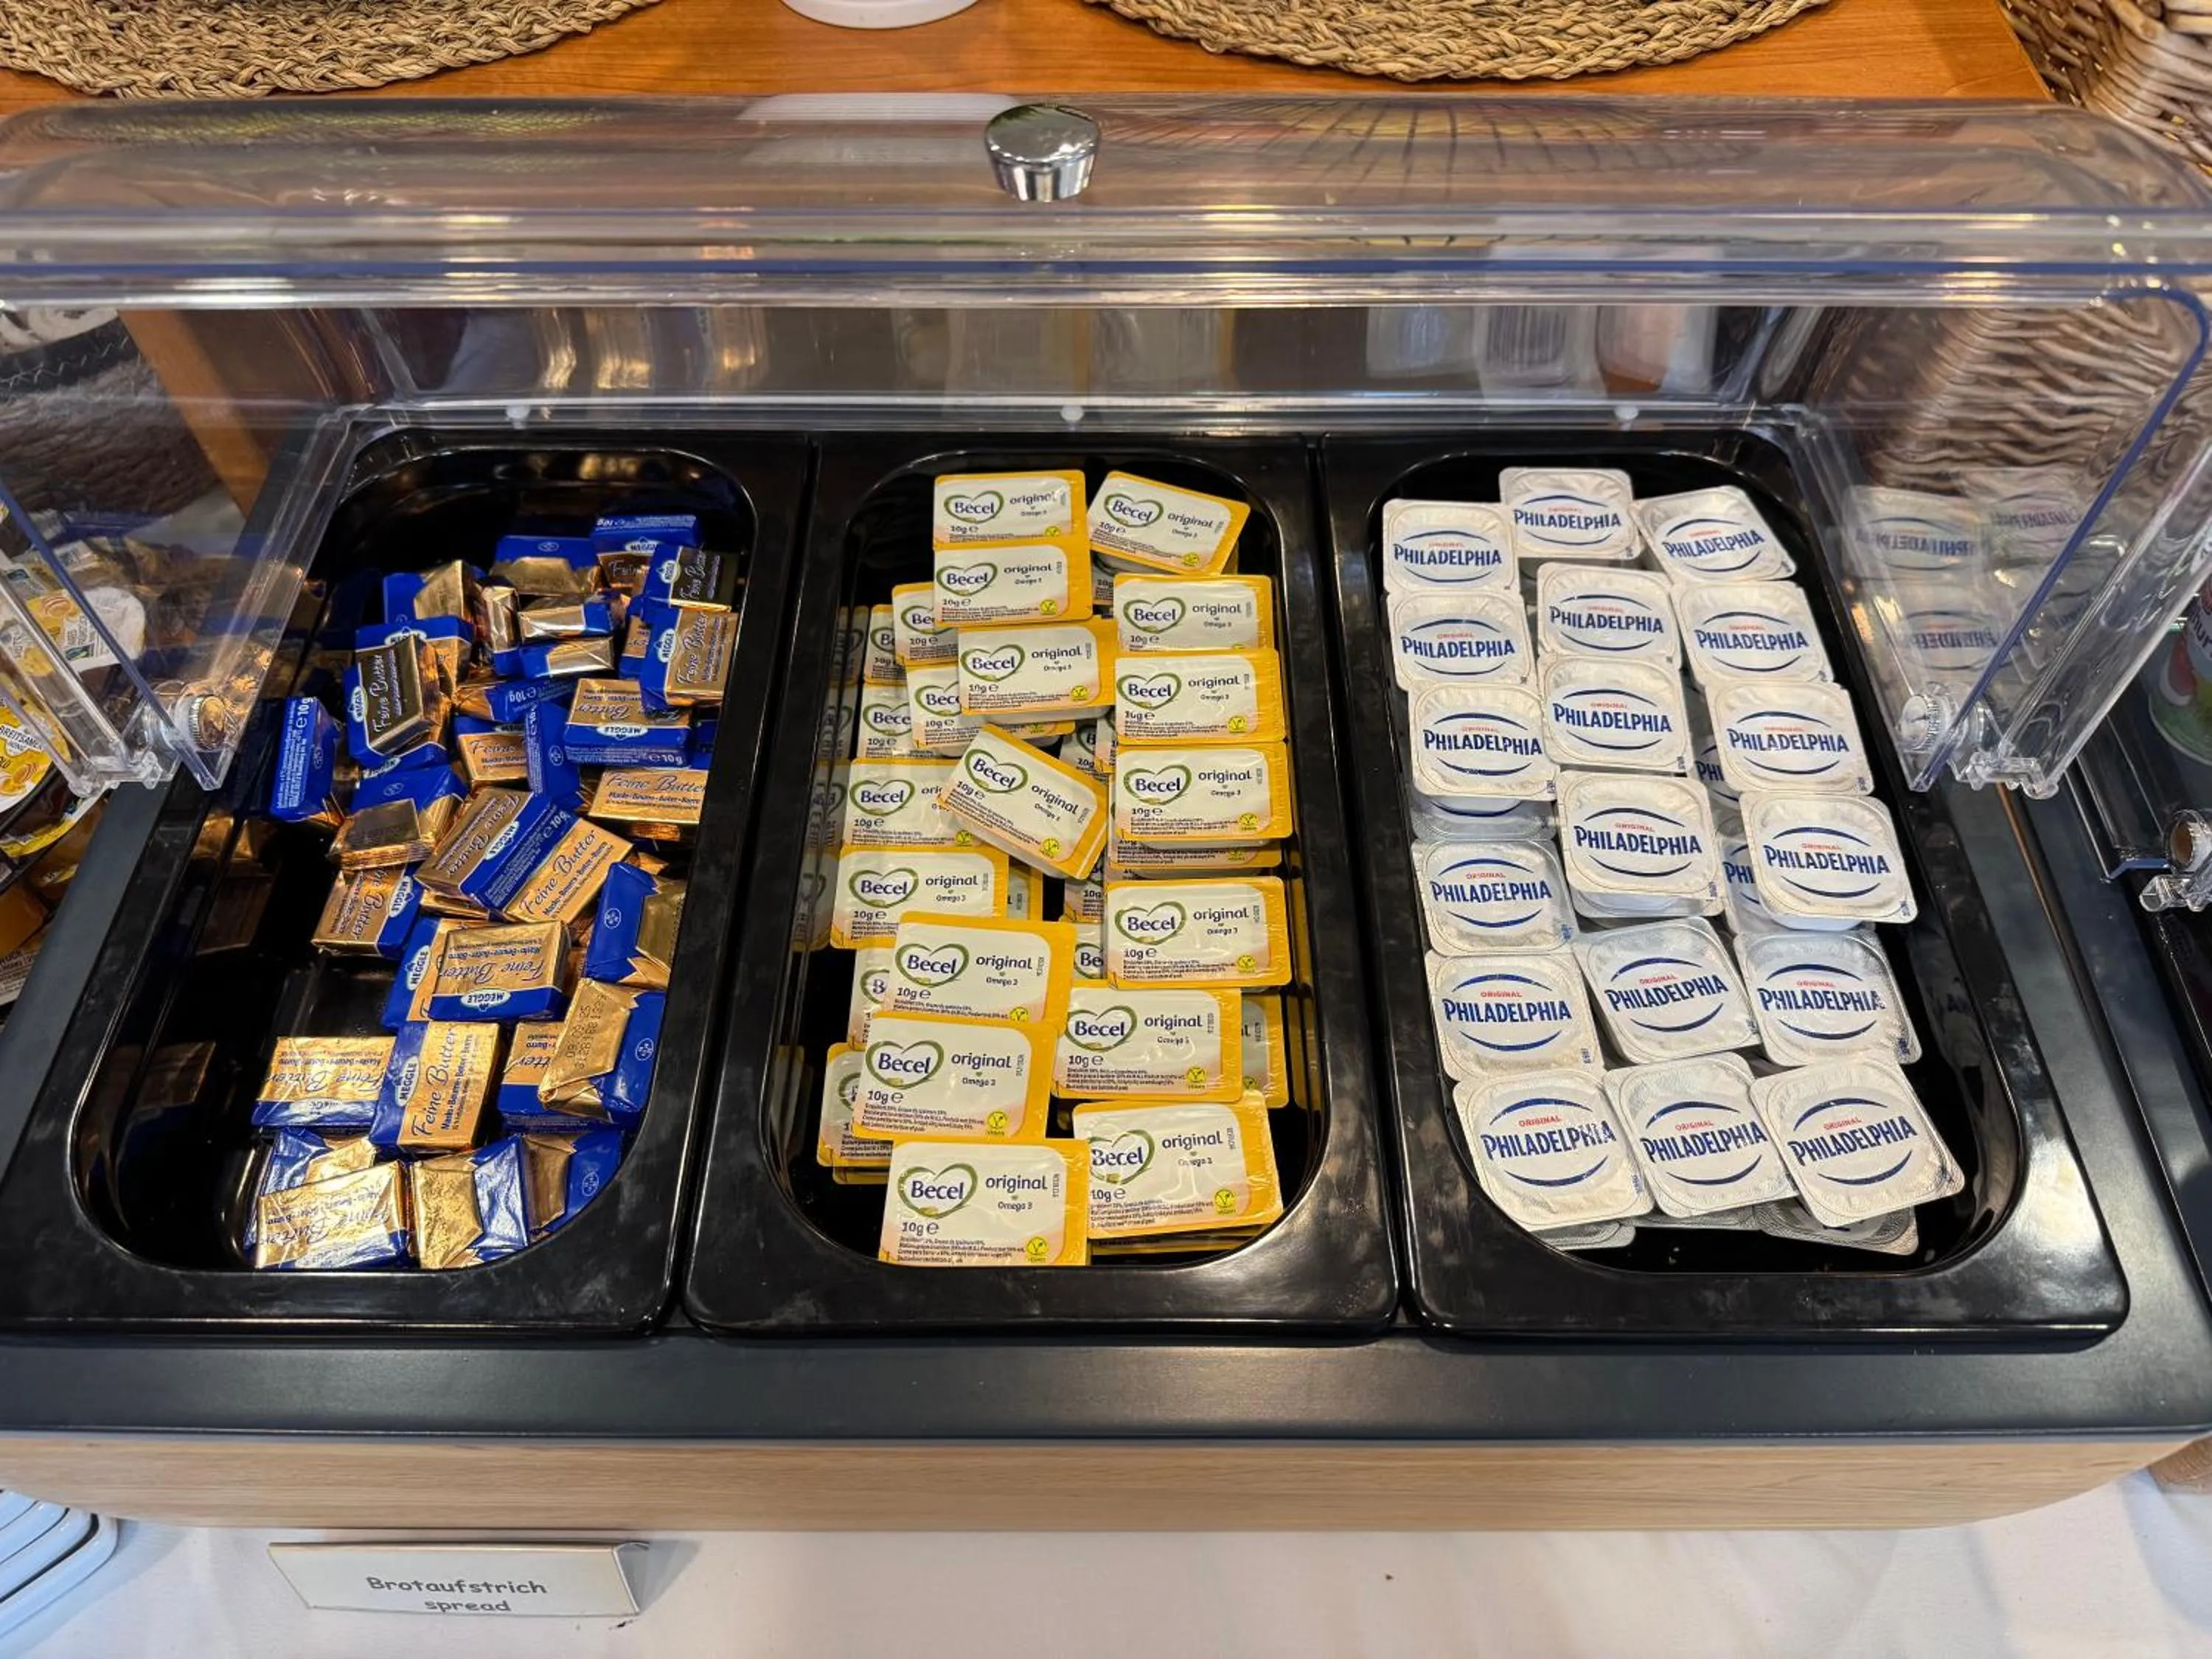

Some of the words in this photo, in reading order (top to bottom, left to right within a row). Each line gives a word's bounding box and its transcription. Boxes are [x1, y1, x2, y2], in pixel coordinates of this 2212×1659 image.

[955, 501, 995, 514] Becel
[1113, 501, 1155, 522] Becel
[1099, 521, 1116, 532] 10g
[1167, 512, 1214, 529] original
[1514, 509, 1621, 530] PHILADELPHIA
[950, 525, 967, 534] 10g
[1663, 529, 1765, 557] PHILADELPHIA
[1394, 543, 1502, 566] PHILADELPHIA
[1004, 563, 1053, 575] original
[947, 571, 989, 585] Becel
[942, 598, 959, 608] 10g
[1192, 602, 1242, 615] original
[1134, 608, 1176, 622] Becel
[1549, 605, 1663, 633] PHILADELPHIA
[682, 612, 709, 650] Butter
[1130, 635, 1147, 644] 10g
[1402, 636, 1515, 658] PHILADELPHIA
[1694, 629, 1809, 651] PHILADELPHIA
[1032, 647, 1082, 659] original
[677, 654, 698, 684] Feine
[972, 657, 1015, 669] Becel
[969, 684, 987, 693] 10g
[1189, 675, 1240, 689] original
[1128, 684, 1172, 698] Becel
[298, 698, 313, 715] 10g
[926, 693, 959, 705] Bec
[874, 712, 911, 725] Bece
[1553, 703, 1672, 732] PHILADELPHIA
[868, 737, 886, 748] 10g
[1423, 729, 1542, 755] PHILADELPHIA
[1727, 728, 1849, 752] PHILADELPHIA
[661, 754, 682, 765] 10g
[973, 758, 1015, 788] Becel
[1198, 770, 1251, 783] original
[608, 776, 649, 789] Feine
[959, 781, 975, 796] 10g
[1135, 777, 1180, 791] Becel
[860, 790, 904, 804] Becel
[1032, 783, 1079, 815] original
[1131, 807, 1151, 817] 10g
[855, 818, 872, 827] 10g
[1574, 825, 1703, 855] PHILADELPHIA
[1763, 845, 1891, 874] PHILADELPHIA
[520, 878, 557, 914] Feine
[554, 830, 596, 875] Butter
[860, 880, 908, 894] Becel
[926, 874, 978, 887] original
[392, 881, 408, 911] MEGGLE
[1430, 880, 1552, 902] PHILADELPHIA
[352, 894, 383, 939] Butter
[854, 911, 874, 920] 10g
[1194, 908, 1249, 921] original
[1127, 917, 1175, 931] Becel
[1124, 948, 1144, 959] 10g
[411, 951, 428, 984] MEGGLE
[501, 959, 544, 981] Feine
[908, 955, 957, 974] Becel
[975, 955, 1032, 970] original
[442, 962, 496, 984] Butter
[467, 993, 504, 1004] MEGGLE
[897, 987, 917, 1000] 10g
[1604, 974, 1728, 1011] PHILADELPHIA
[1757, 988, 1885, 1011] PHILADELPHIA
[1442, 998, 1571, 1022] PHILADELPHIA
[1075, 1020, 1124, 1036] Becel
[1144, 1015, 1203, 1030] original
[426, 1027, 458, 1086] Butter
[878, 1053, 931, 1074] Becel
[951, 1053, 1012, 1068] original
[1068, 1055, 1089, 1067] 10g
[400, 1062, 417, 1100] MEGGLE
[962, 1078, 989, 1086] Omega
[868, 1091, 888, 1104] 10g
[411, 1091, 442, 1136] Feine
[1518, 1115, 1562, 1127] ORIGINAL
[1674, 1120, 1714, 1132] ORIGINAL
[1824, 1117, 1862, 1130] ORIGINAL
[1162, 1131, 1223, 1150] original
[1481, 1120, 1616, 1161] PHILADELPHIA
[1640, 1121, 1767, 1164] PHILADELPHIA
[1788, 1116, 1917, 1166] PHILADELPHIA
[911, 1180, 964, 1200] Becel
[986, 1176, 1047, 1192] original
[1091, 1189, 1112, 1202] 10g
[998, 1201, 1026, 1211] Omega
[902, 1222, 924, 1236] 10g
[366, 1577, 546, 1594] Brotaufstrich
[425, 1600, 510, 1613] spread
